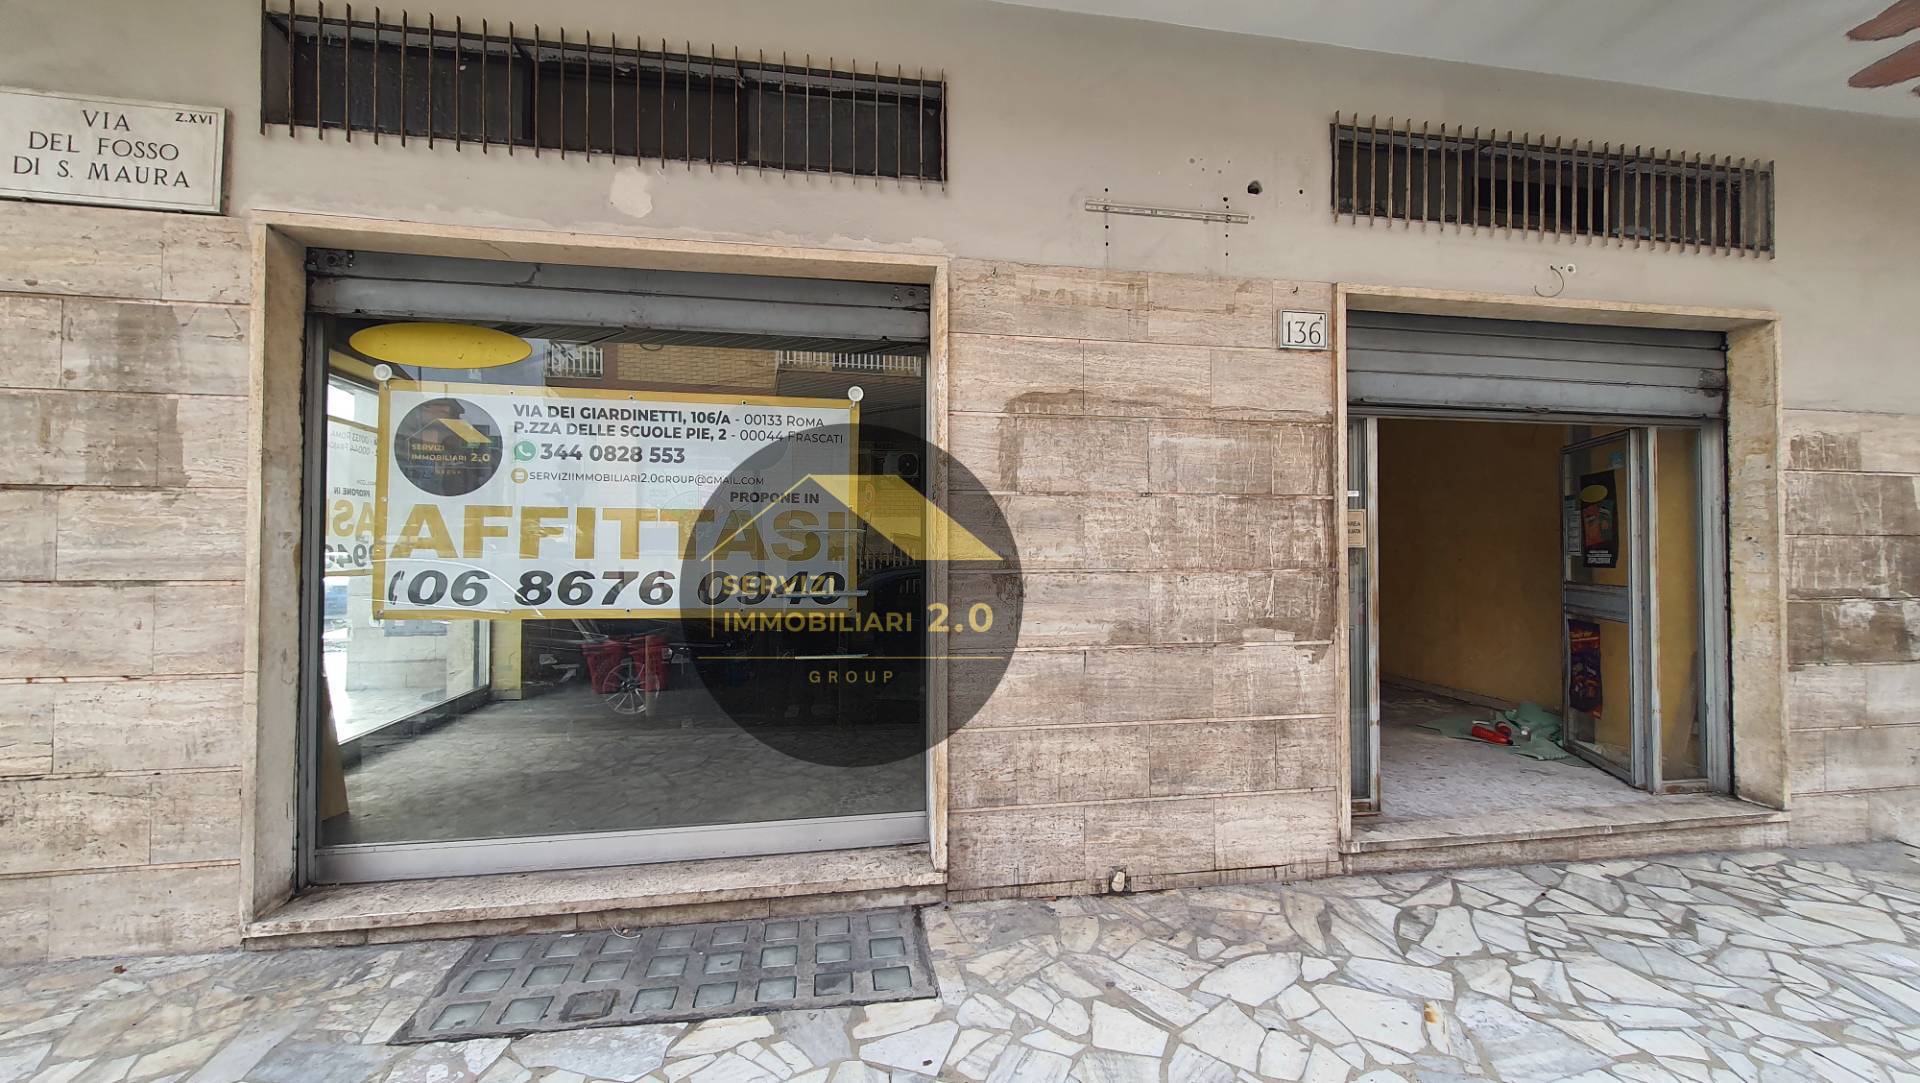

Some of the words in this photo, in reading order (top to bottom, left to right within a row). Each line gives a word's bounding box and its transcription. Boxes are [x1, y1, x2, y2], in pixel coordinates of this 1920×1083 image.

[81, 109, 131, 132] VIA
[175, 112, 213, 126] Z.XVI
[28, 131, 80, 153] DEL
[97, 137, 180, 161] FOSSO
[13, 155, 40, 176] DI
[57, 159, 74, 178] S.
[87, 162, 190, 188] MAURA
[1287, 321, 1321, 345] 136
[513, 403, 543, 418] VIA
[547, 405, 575, 419] DEI
[580, 406, 687, 425] GIARDINETTI,
[691, 410, 731, 425] 106/A
[744, 413, 783, 427] 00133
[513, 421, 561, 435] P.ZZA
[566, 422, 612, 437] DELLE
[620, 424, 683, 439] SCUOLE
[686, 427, 714, 442] PIE,
[718, 428, 727, 440] 2
[739, 429, 784, 442] 00044
[540, 443, 583, 460] 344
[589, 445, 643, 463] 0828
[650, 447, 686, 464] 553
[730, 491, 800, 504] PROPONE
[804, 493, 820, 504] IN
[388, 503, 850, 562] AFFITTASI
[406, 569, 491, 607] 06
[514, 569, 676, 606] 8676
